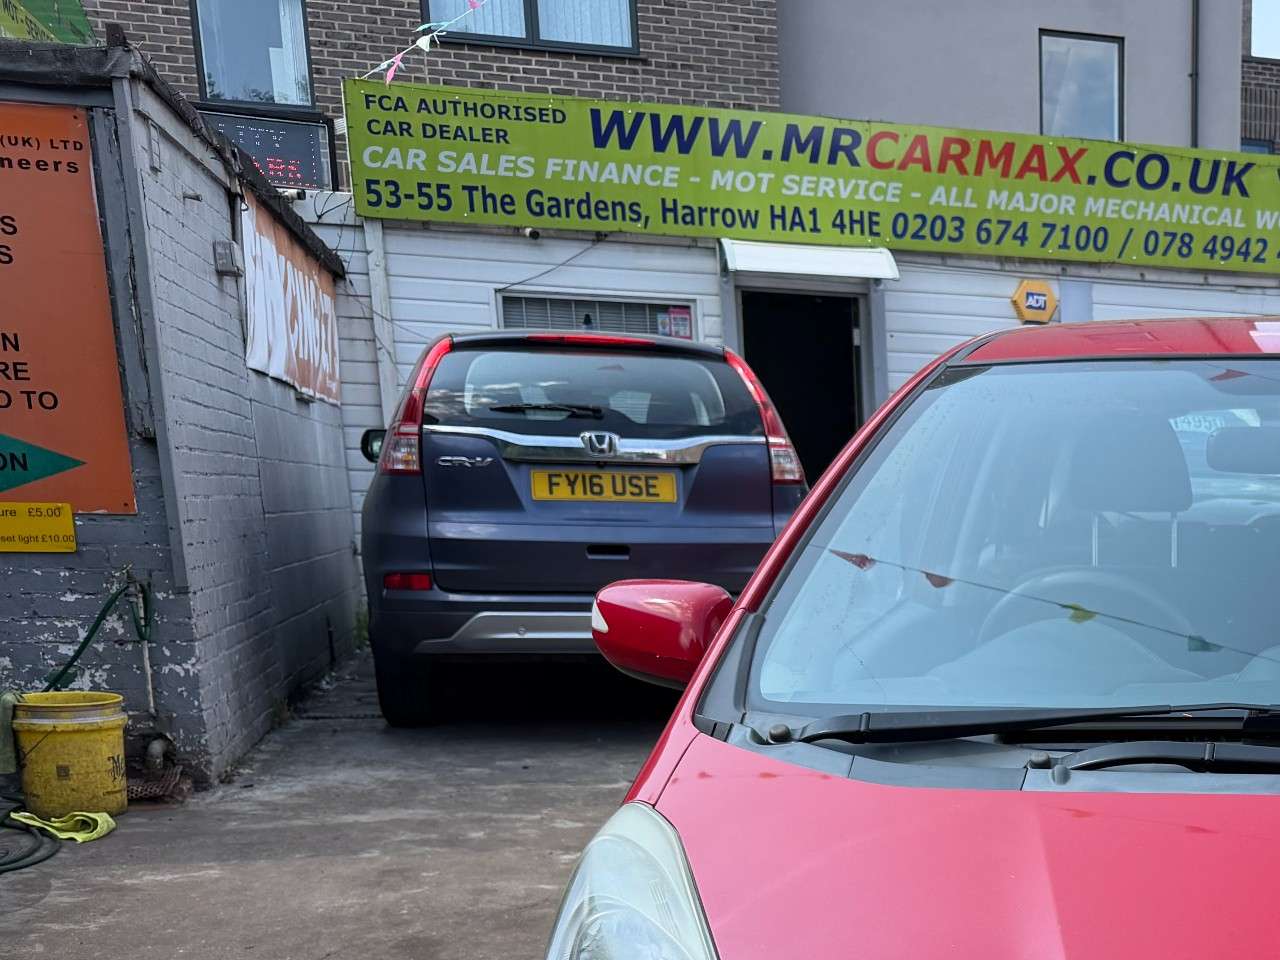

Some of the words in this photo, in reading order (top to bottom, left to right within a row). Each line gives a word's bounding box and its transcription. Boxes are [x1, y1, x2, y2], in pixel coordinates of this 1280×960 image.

[364, 94, 409, 113] FCA
[416, 99, 567, 124] AUTHORISED
[367, 119, 414, 137] CAR
[421, 123, 511, 145] DEALER
[49, 139, 84, 151] LTD
[589, 107, 1256, 198] WWW.MRCARMAX.CO.UK
[362, 146, 427, 171] CAR
[437, 150, 536, 178] SALES
[545, 158, 681, 188] FINANCE
[711, 170, 775, 194] MOT
[781, 174, 903, 203] SERVICE
[929, 186, 978, 208] ALL
[987, 190, 1076, 216] MAJOR
[1084, 197, 1247, 228] MECHANICAL
[365, 178, 453, 212] 53-55
[462, 185, 516, 215] The
[526, 189, 650, 229] Gardens,
[660, 198, 760, 229] Harrow
[769, 205, 822, 234] HA1
[831, 209, 881, 237] 4HE
[891, 212, 965, 243] 0203
[976, 218, 1029, 247] 674
[1041, 222, 1109, 252] 7100
[1117, 228, 1134, 259] /
[1143, 229, 1194, 258] 078
[1203, 234, 1268, 263] 4942
[20, 390, 58, 410] TO
[547, 473, 604, 497] FY16
[612, 475, 660, 498] USE
[28, 507, 61, 517] £5.00
[19, 534, 40, 544] light
[41, 534, 75, 543] £10.00
